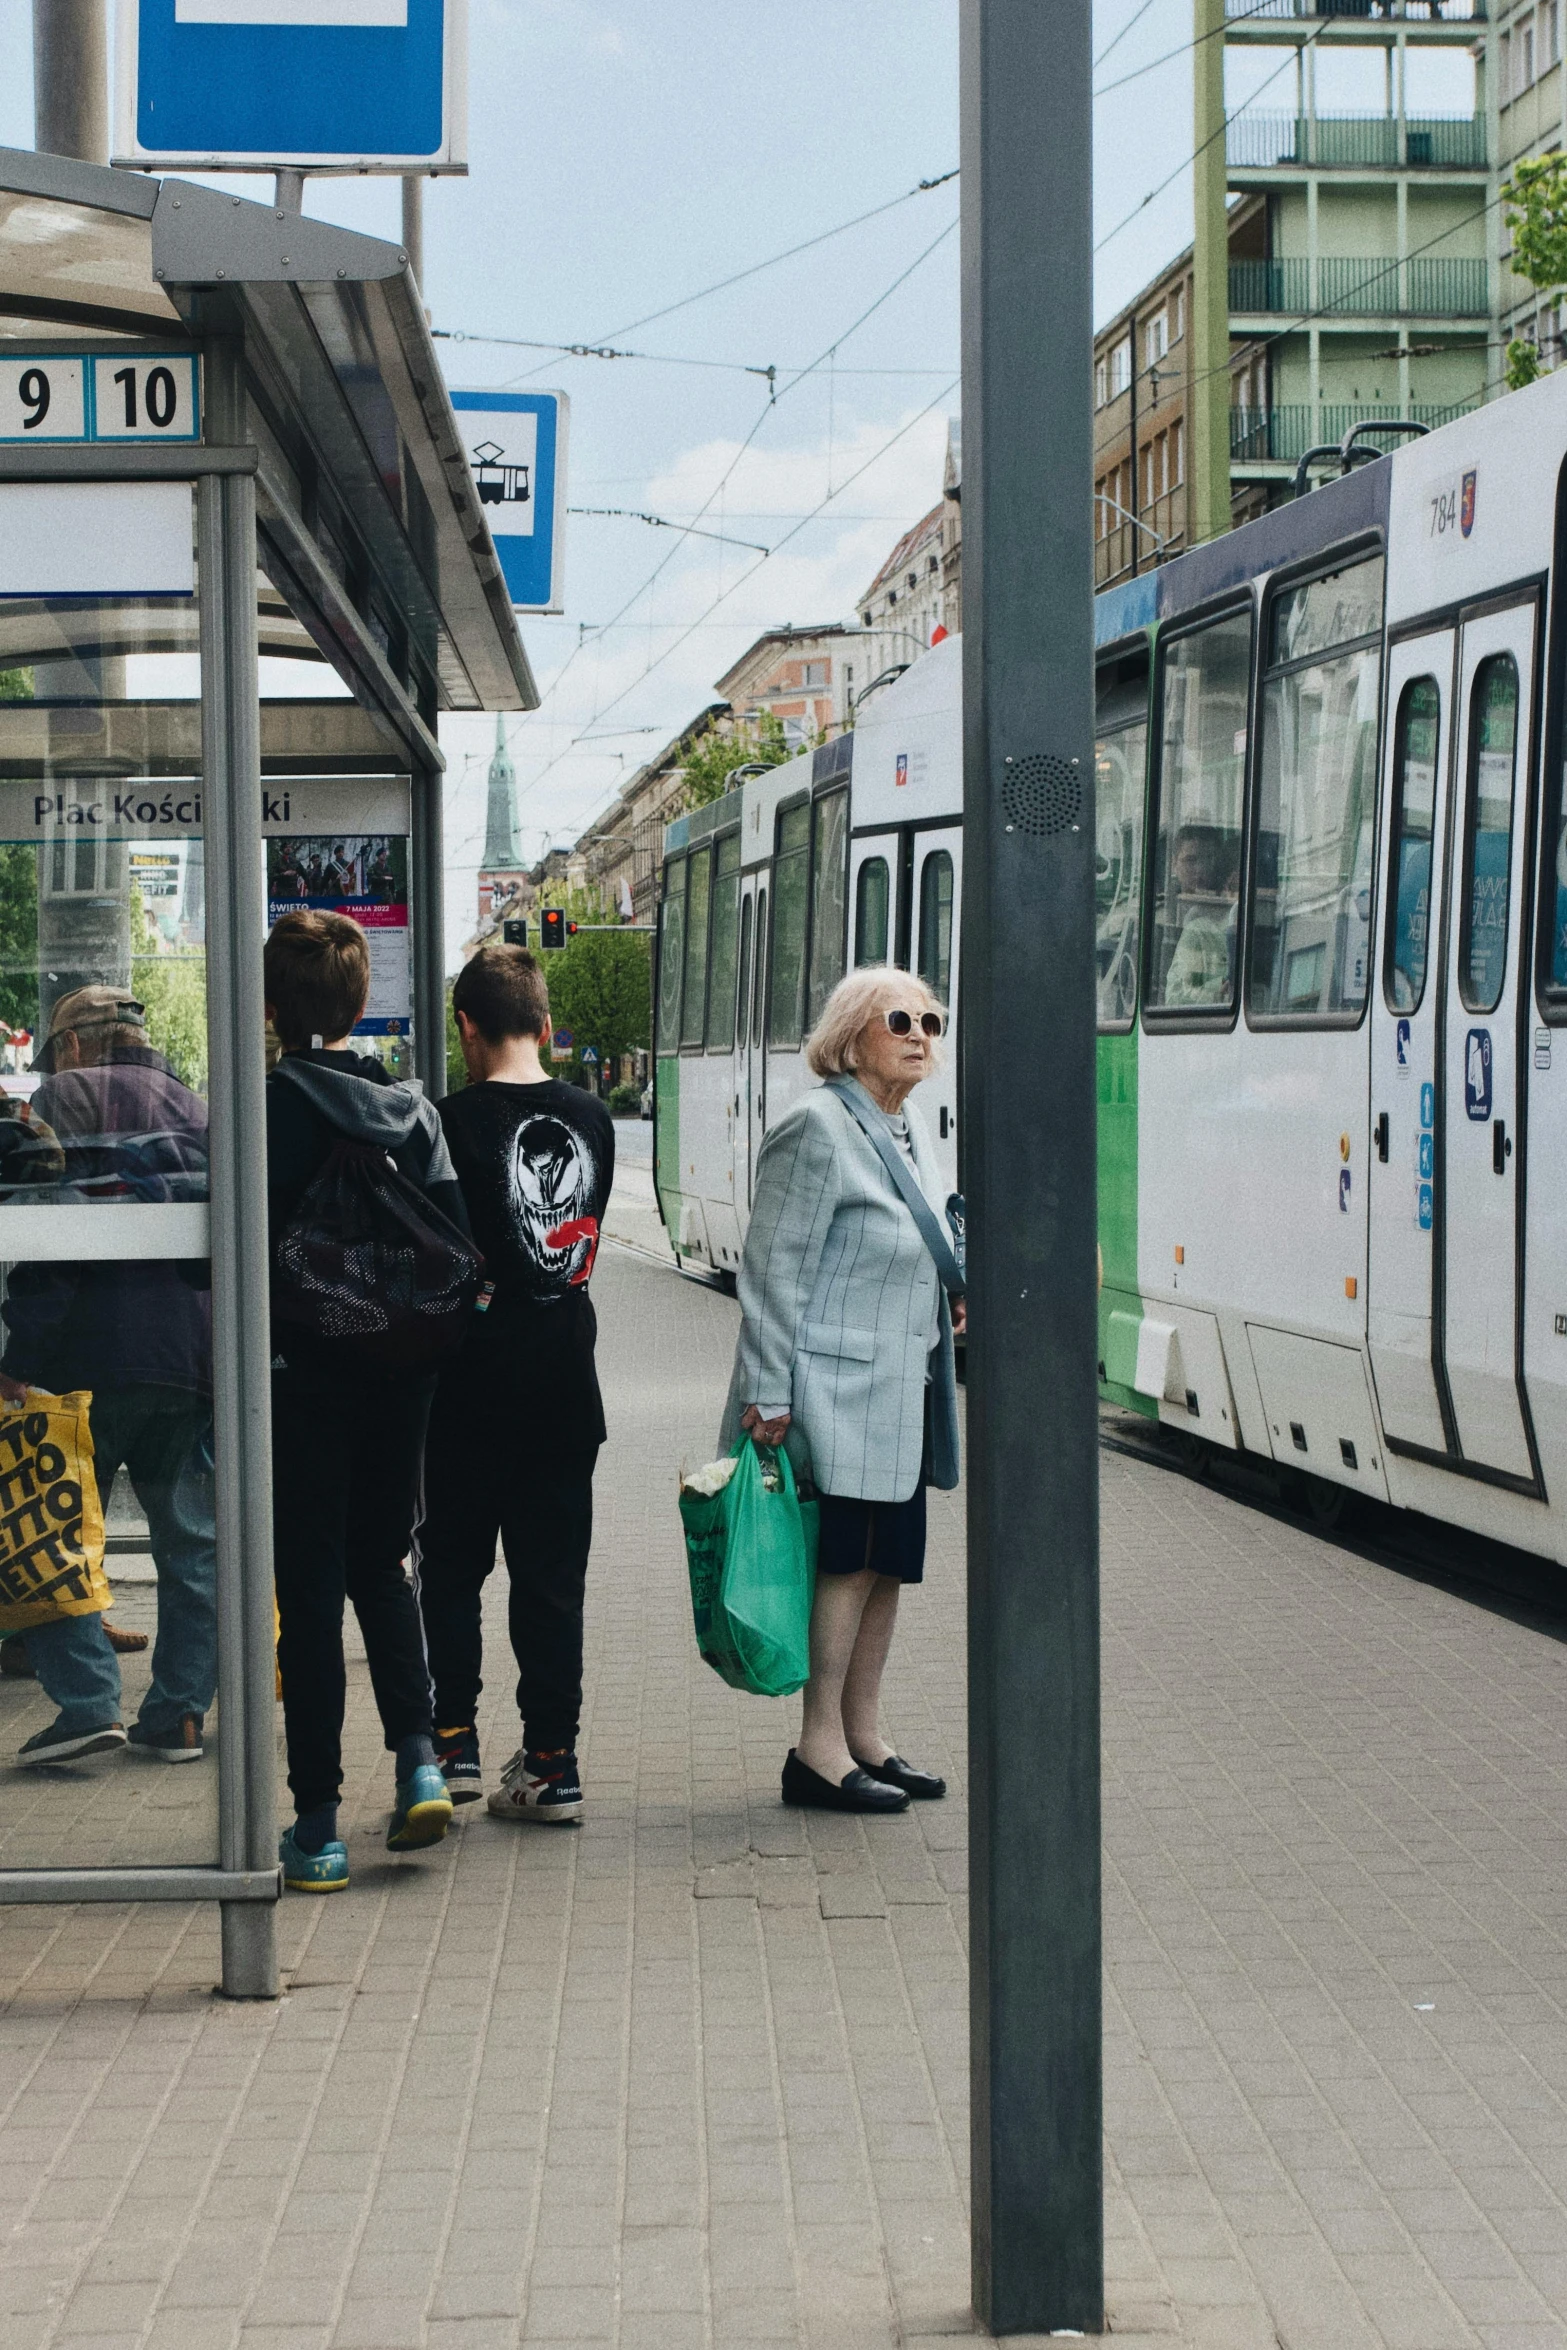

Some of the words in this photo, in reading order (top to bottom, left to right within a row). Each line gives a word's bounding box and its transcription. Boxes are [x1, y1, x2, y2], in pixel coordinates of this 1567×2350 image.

[18, 368, 50, 429] 9
[114, 366, 177, 428] 10
[1430, 489, 1456, 538] 784
[34, 794, 104, 825] Plac
